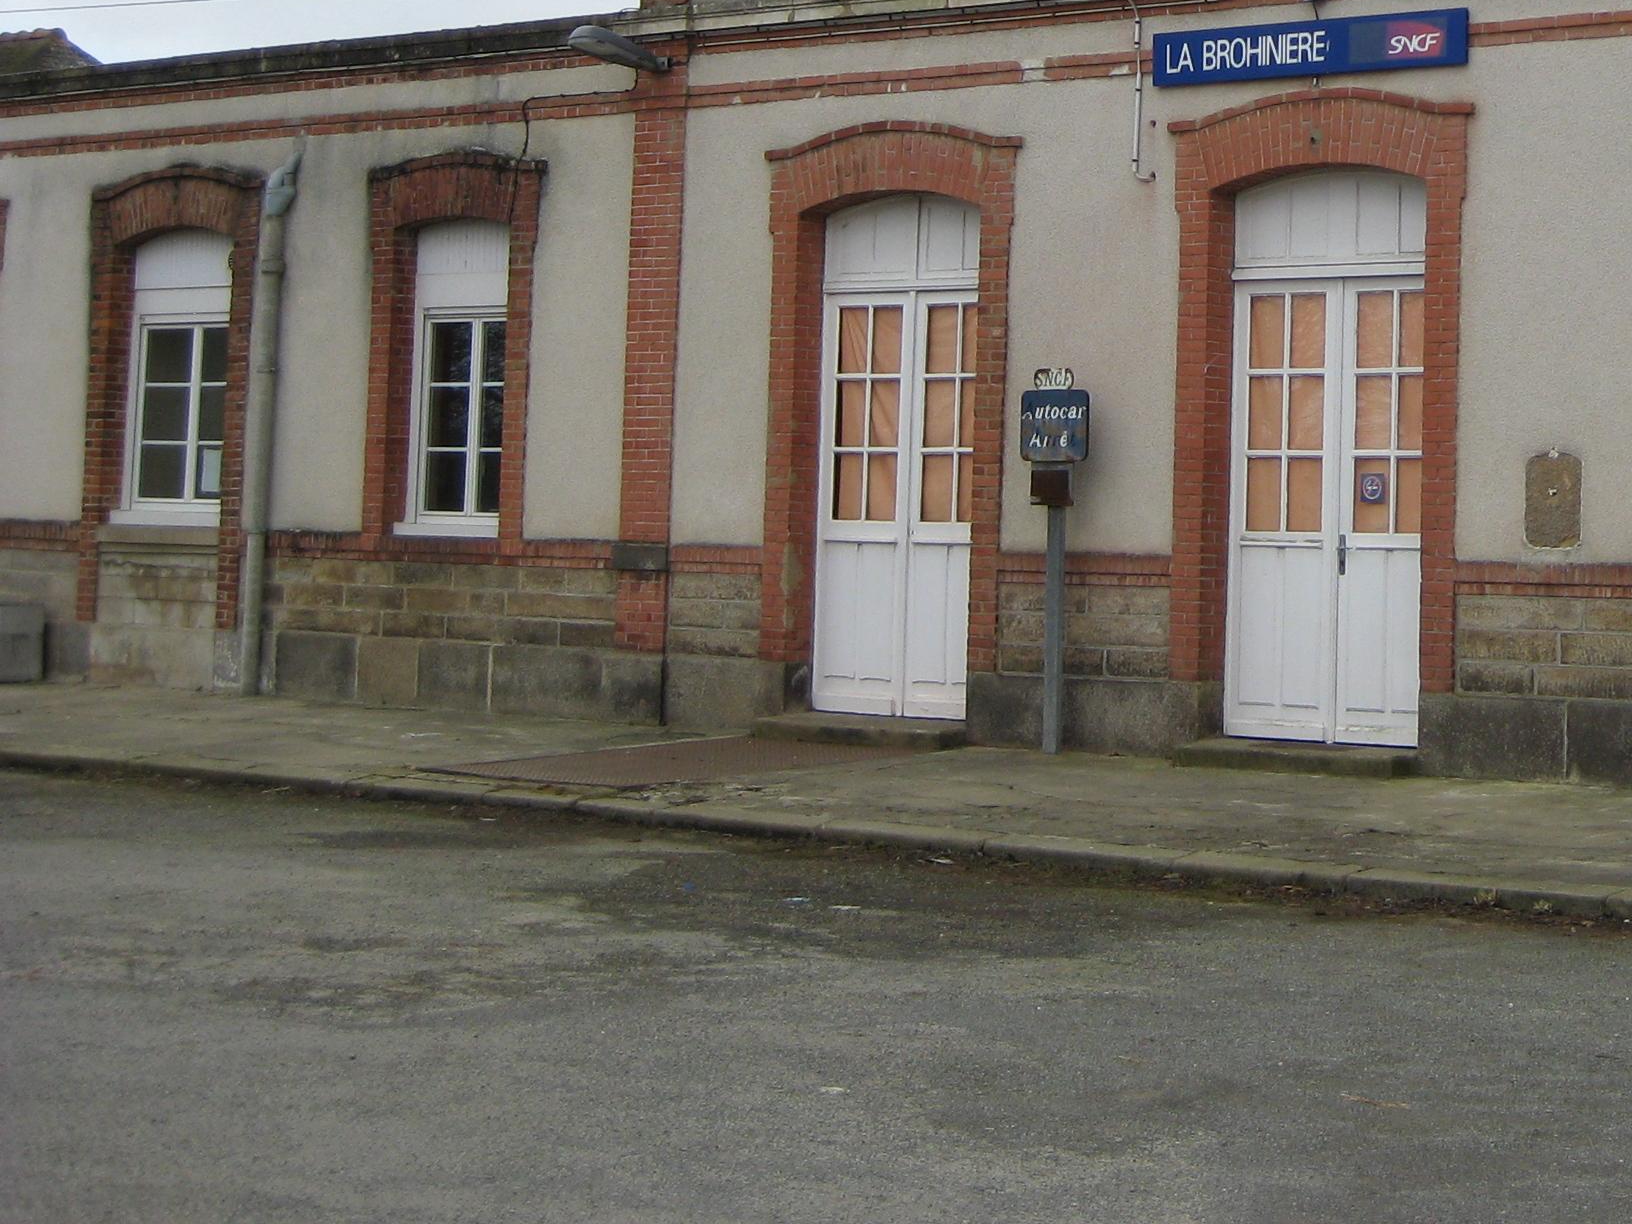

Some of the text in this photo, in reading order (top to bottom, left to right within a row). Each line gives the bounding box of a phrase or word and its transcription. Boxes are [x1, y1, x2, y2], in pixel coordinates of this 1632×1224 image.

[1166, 30, 1441, 74] LA BROHINIERE SNCF
[1035, 370, 1071, 388] SNCF
